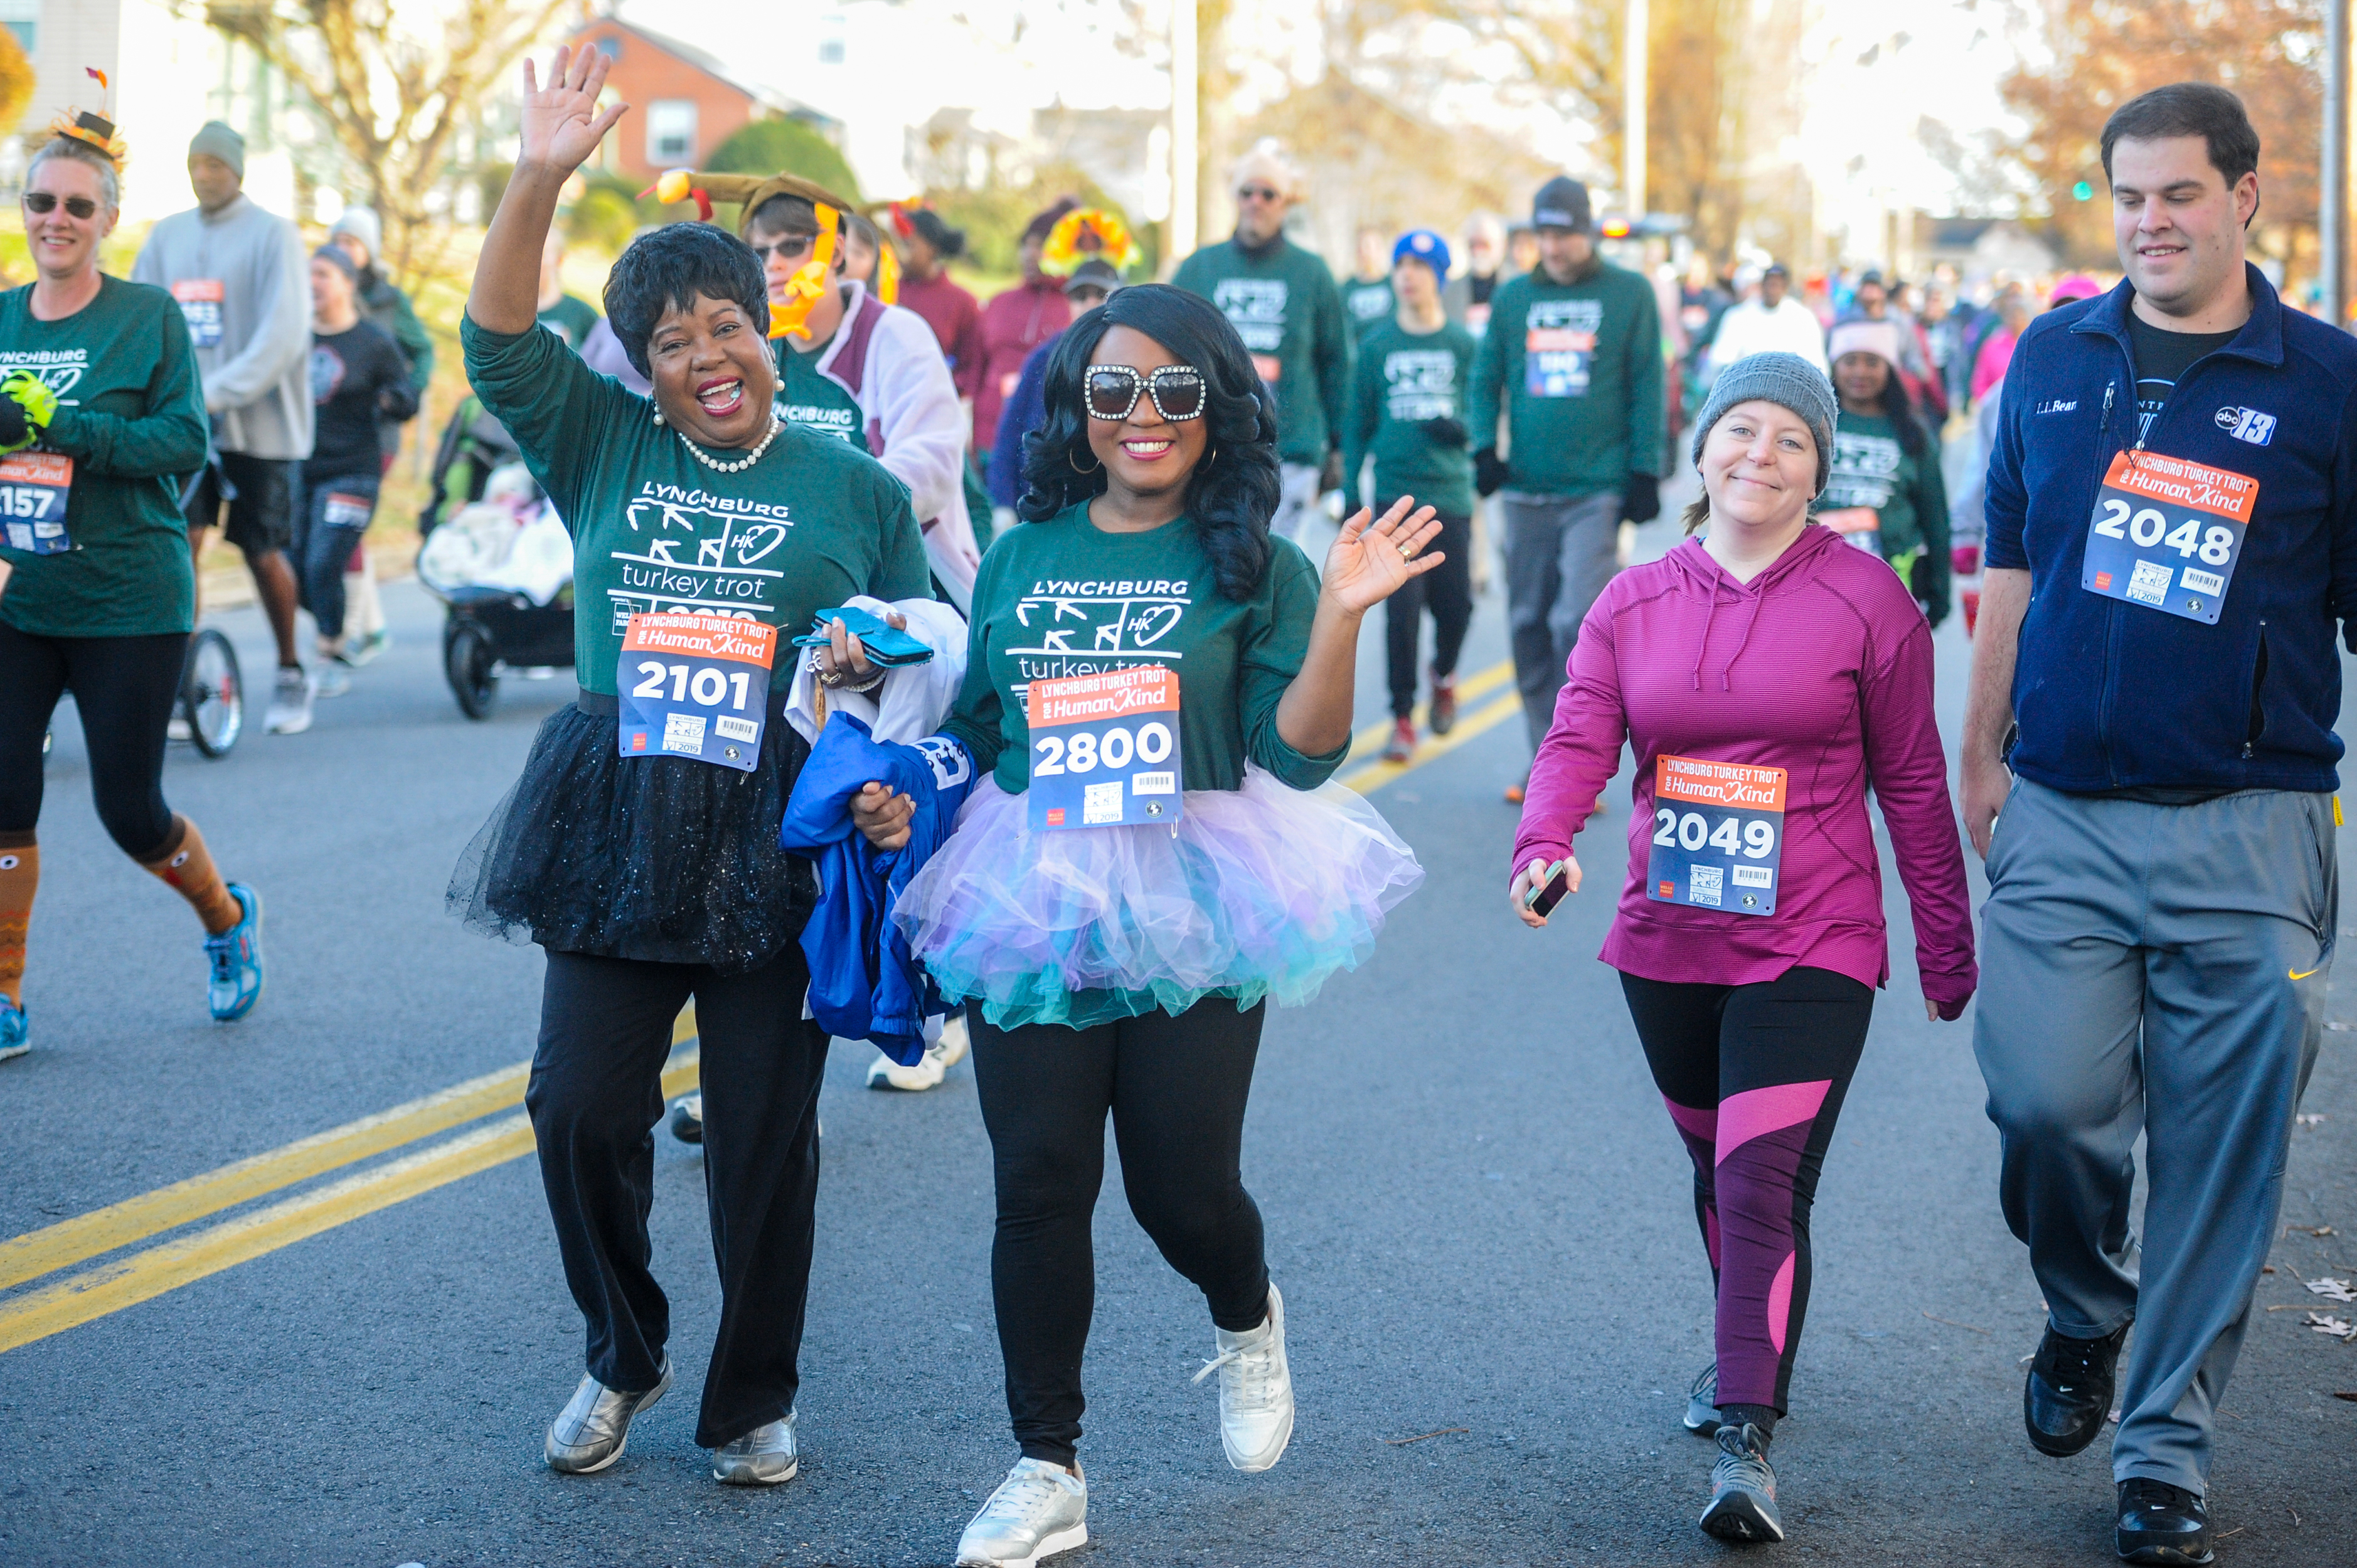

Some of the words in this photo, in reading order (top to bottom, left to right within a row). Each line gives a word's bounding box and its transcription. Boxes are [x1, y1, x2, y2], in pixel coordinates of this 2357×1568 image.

[2233, 410, 2274, 444] 13
[2119, 469, 2131, 484] FOR
[2129, 453, 2183, 477] LYNCHBURG
[2184, 465, 2223, 486] TURKEY
[2224, 475, 2250, 494] TROT
[0, 486, 56, 519] 157
[642, 481, 789, 517] LYNCHBURG
[730, 534, 757, 548] HK
[2094, 499, 2234, 566] 2048
[2137, 561, 2171, 575] LYNCHBURG
[623, 564, 708, 598] turkey
[715, 576, 765, 598] trot
[1033, 580, 1188, 595] LYNCHBURG
[2142, 592, 2161, 603] 2019
[641, 615, 700, 630] LYNCHBURG
[701, 618, 741, 635] TURKEY
[743, 623, 769, 640] TROT
[1127, 617, 1154, 631] HK
[637, 630, 647, 644] FOR
[632, 661, 750, 711] 2101
[1042, 679, 1100, 698] LYNCHBURG
[1102, 672, 1141, 690] TURKEY
[1141, 669, 1166, 683] TROT
[1043, 702, 1051, 719] FOR
[678, 743, 698, 753] 2019
[1034, 722, 1172, 777] 2800
[1667, 760, 1712, 777] LYNCHBURG
[1714, 765, 1752, 781] TURKEY
[1753, 770, 1779, 784] TROT
[1100, 813, 1119, 822] 2019
[1654, 808, 1775, 859] 2049
[1702, 896, 1718, 904] 2019
